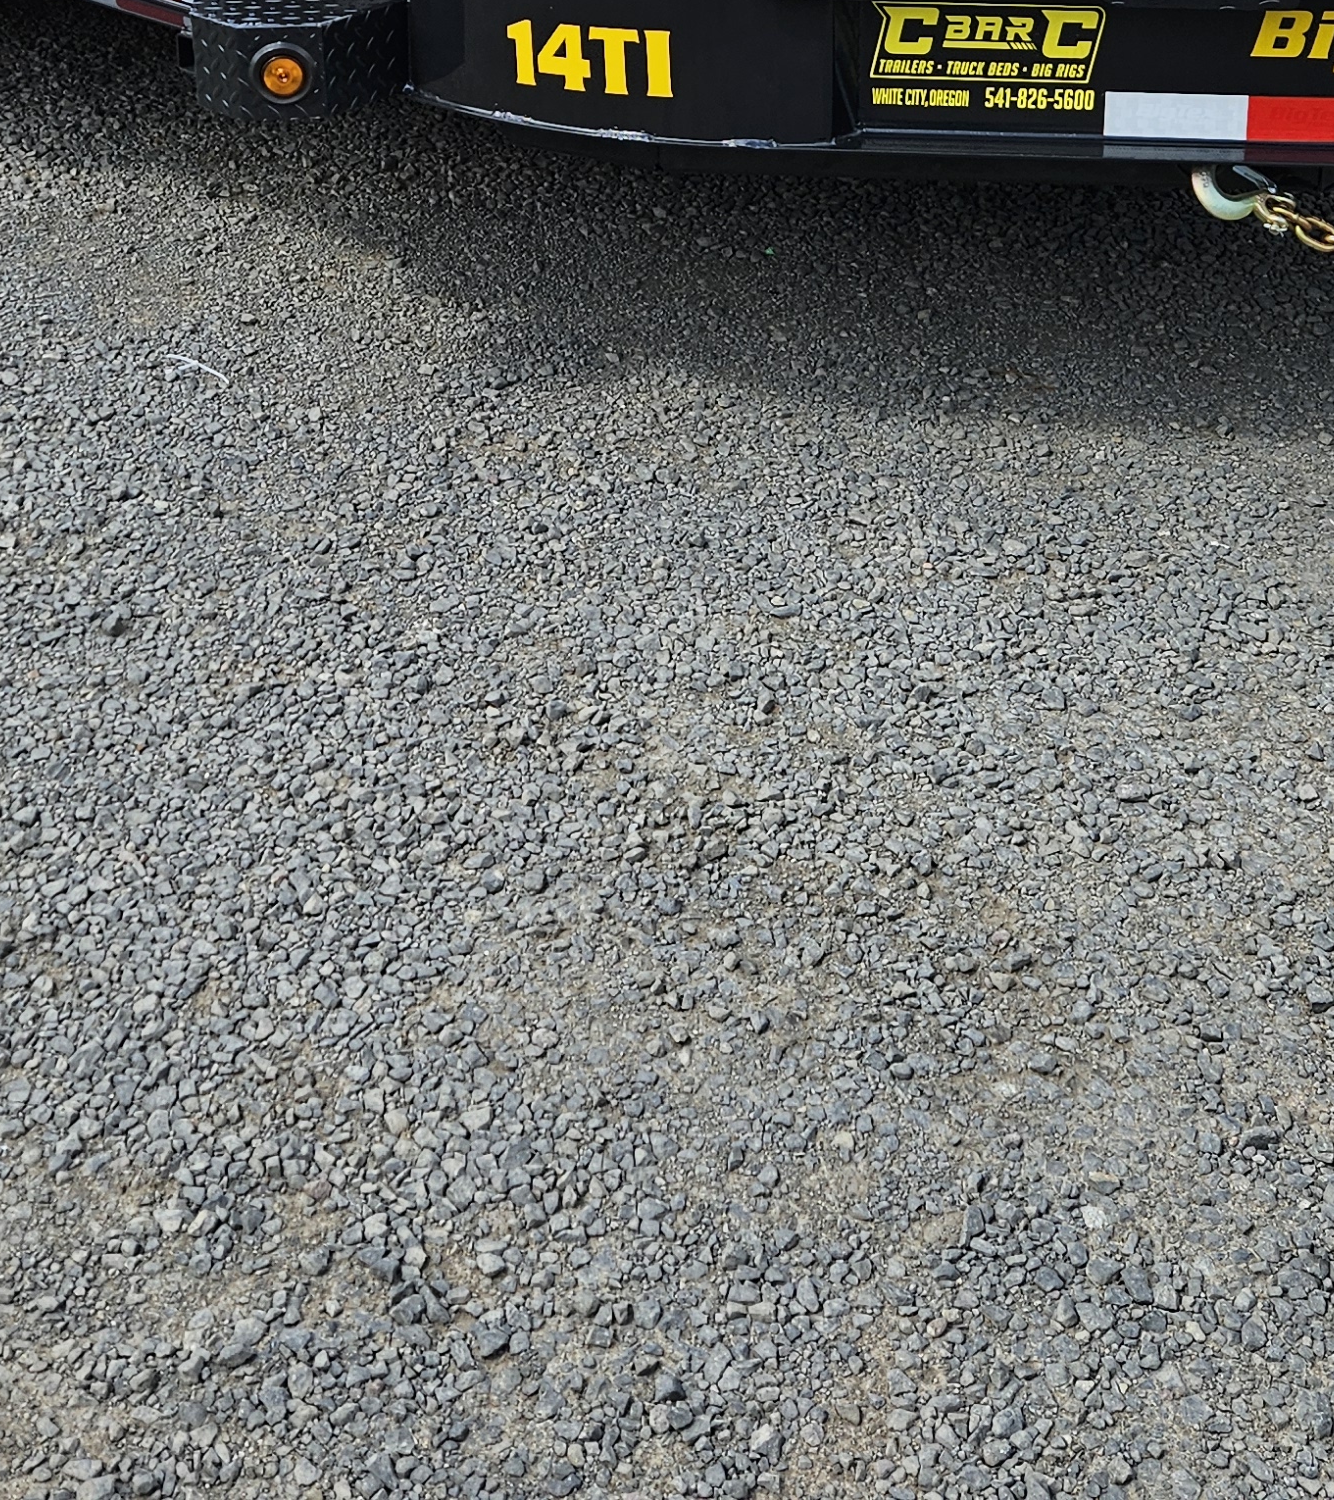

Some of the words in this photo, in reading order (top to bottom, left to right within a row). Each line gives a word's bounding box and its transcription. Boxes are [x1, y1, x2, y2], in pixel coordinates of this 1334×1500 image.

[883, 5, 940, 55] C
[945, 15, 1035, 42] BAR
[1041, 9, 1100, 59] C
[507, 19, 673, 97] 14TI
[879, 58, 934, 74] TRAILERS
[946, 60, 985, 75] TRUCK
[987, 62, 1019, 77] BEDS
[1031, 63, 1053, 78] BIG
[1055, 64, 1086, 78] RIGS
[872, 87, 904, 105] WHITE
[985, 87, 1095, 111] 541-826-5600
